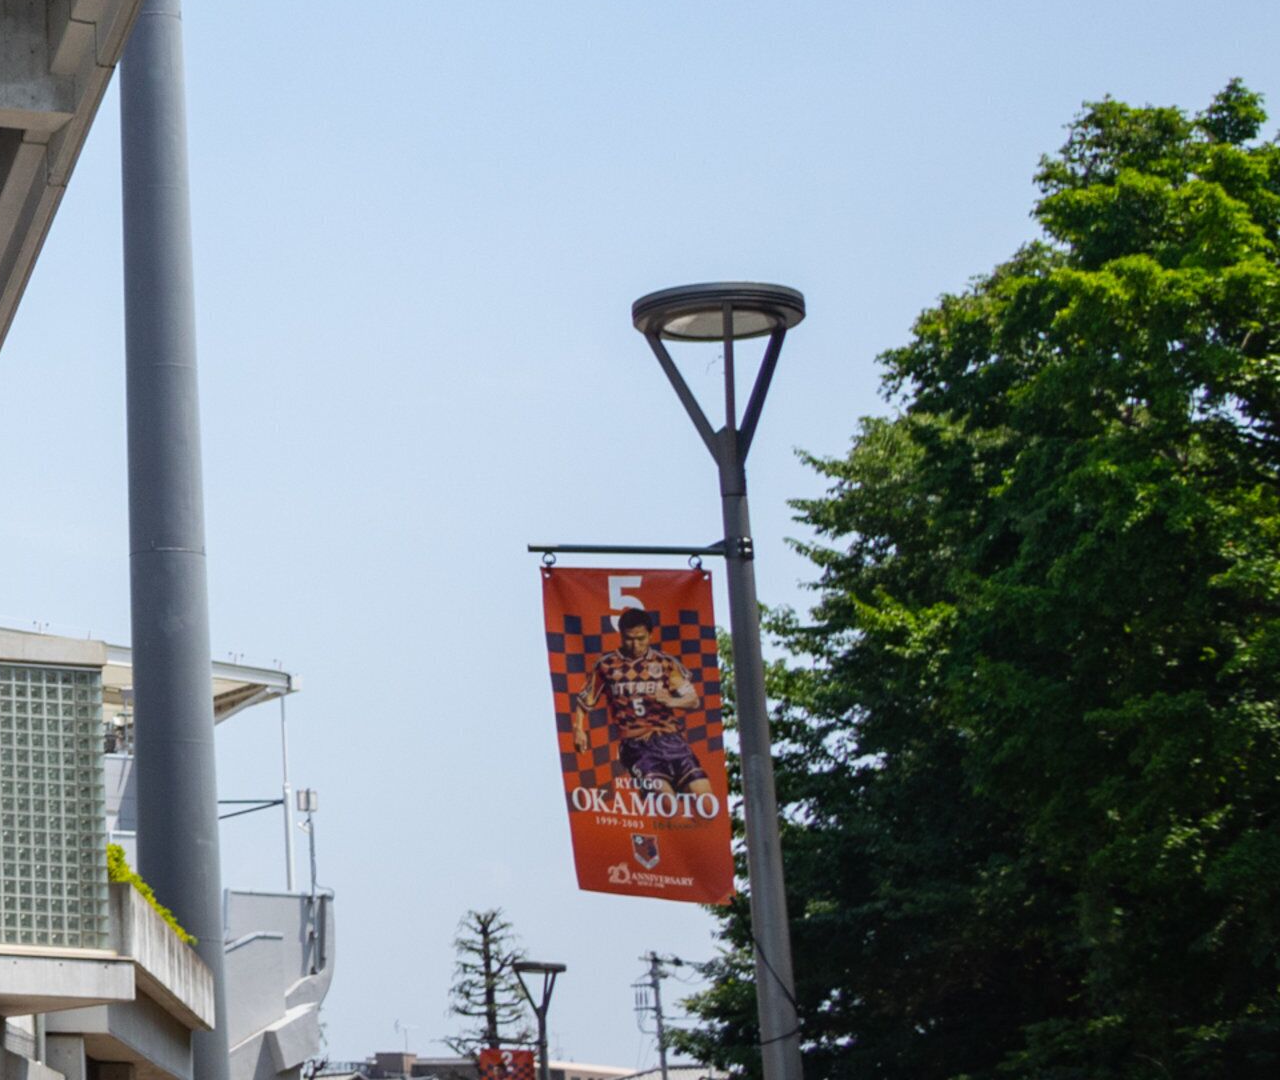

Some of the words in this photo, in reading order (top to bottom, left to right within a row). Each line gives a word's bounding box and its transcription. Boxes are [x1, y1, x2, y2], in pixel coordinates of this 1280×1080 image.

[608, 575, 645, 633] 5
[632, 698, 647, 717] 5
[615, 777, 663, 790] RYUGO
[571, 786, 720, 819] OKAMOTO
[631, 873, 694, 887] ANNIVERSARY
